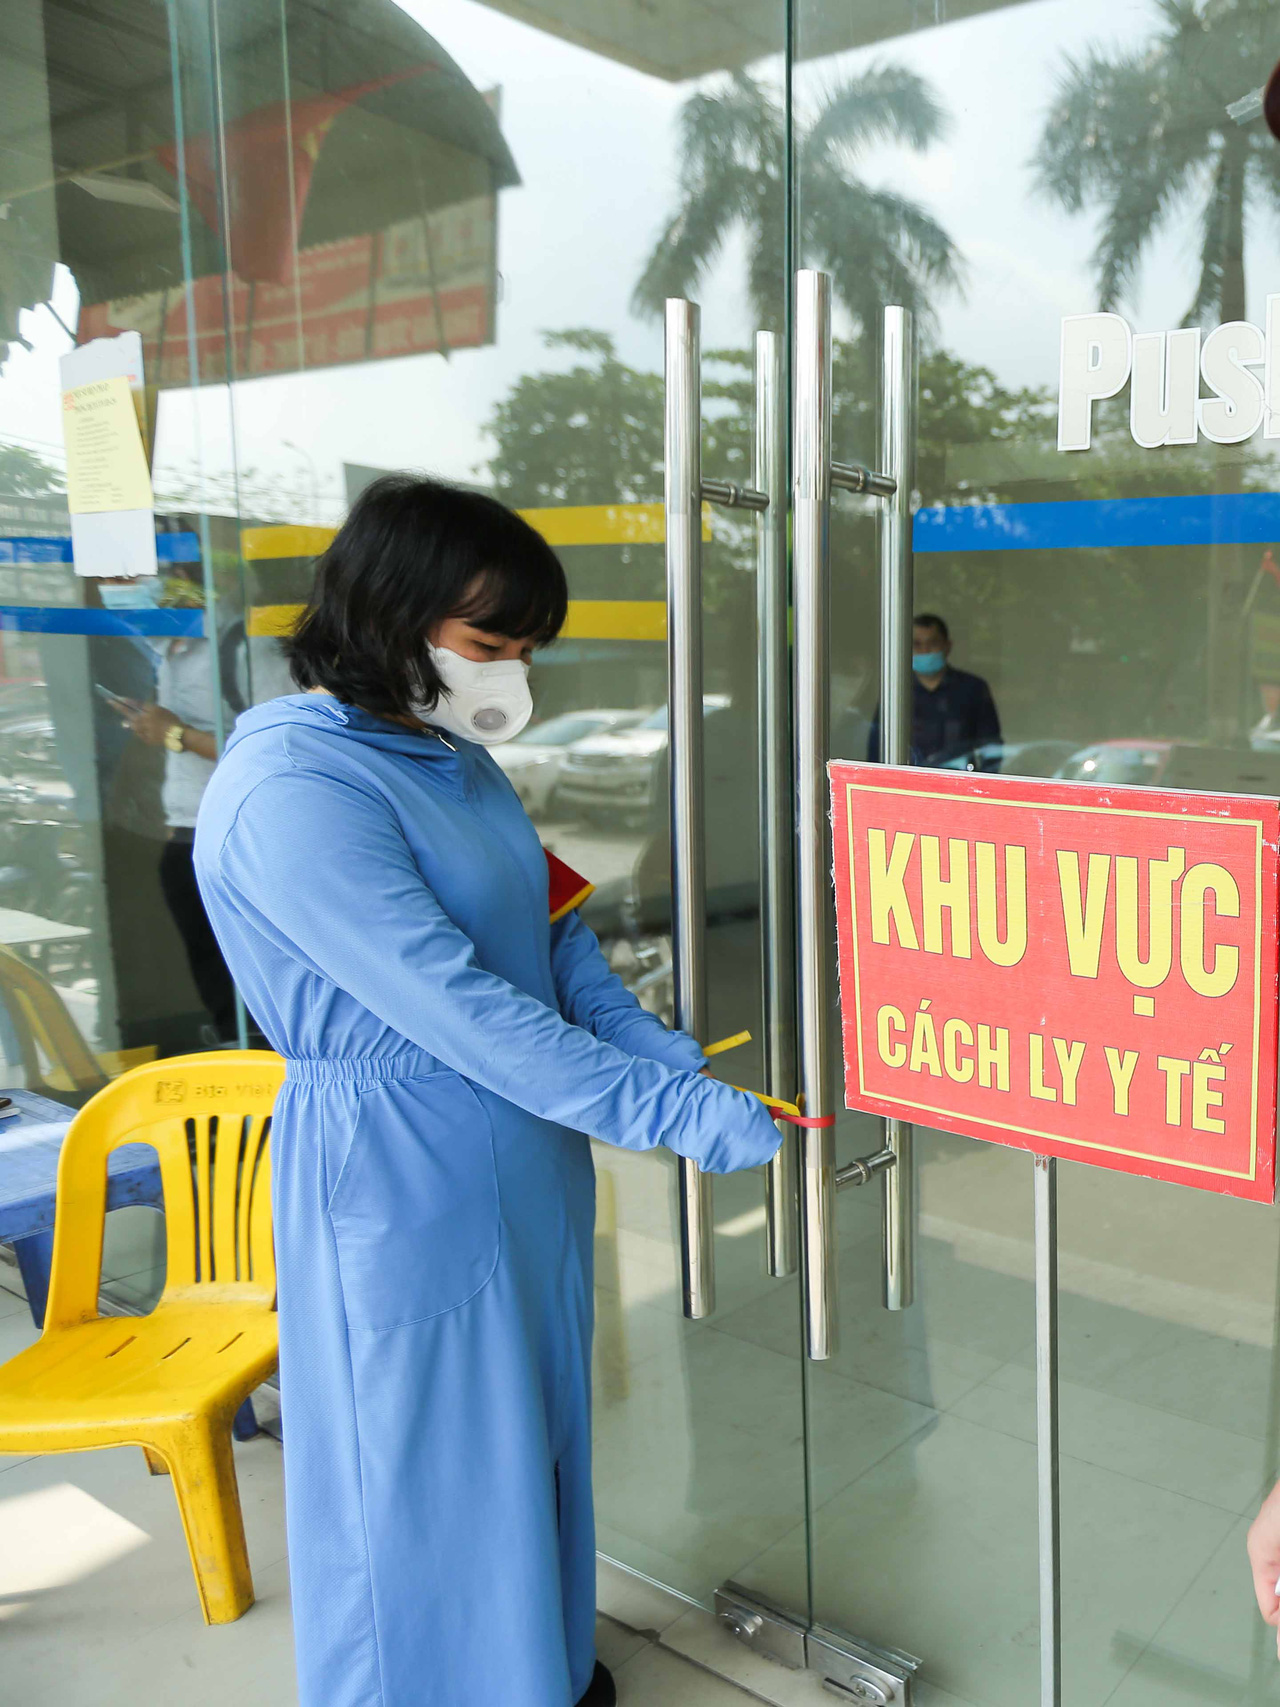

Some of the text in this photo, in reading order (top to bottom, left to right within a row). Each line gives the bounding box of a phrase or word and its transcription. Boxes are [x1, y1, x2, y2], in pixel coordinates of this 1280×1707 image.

[867, 827, 1240, 1018] KHU VỰC
[876, 998, 1234, 1135] CÁCH LY Y TẾ
